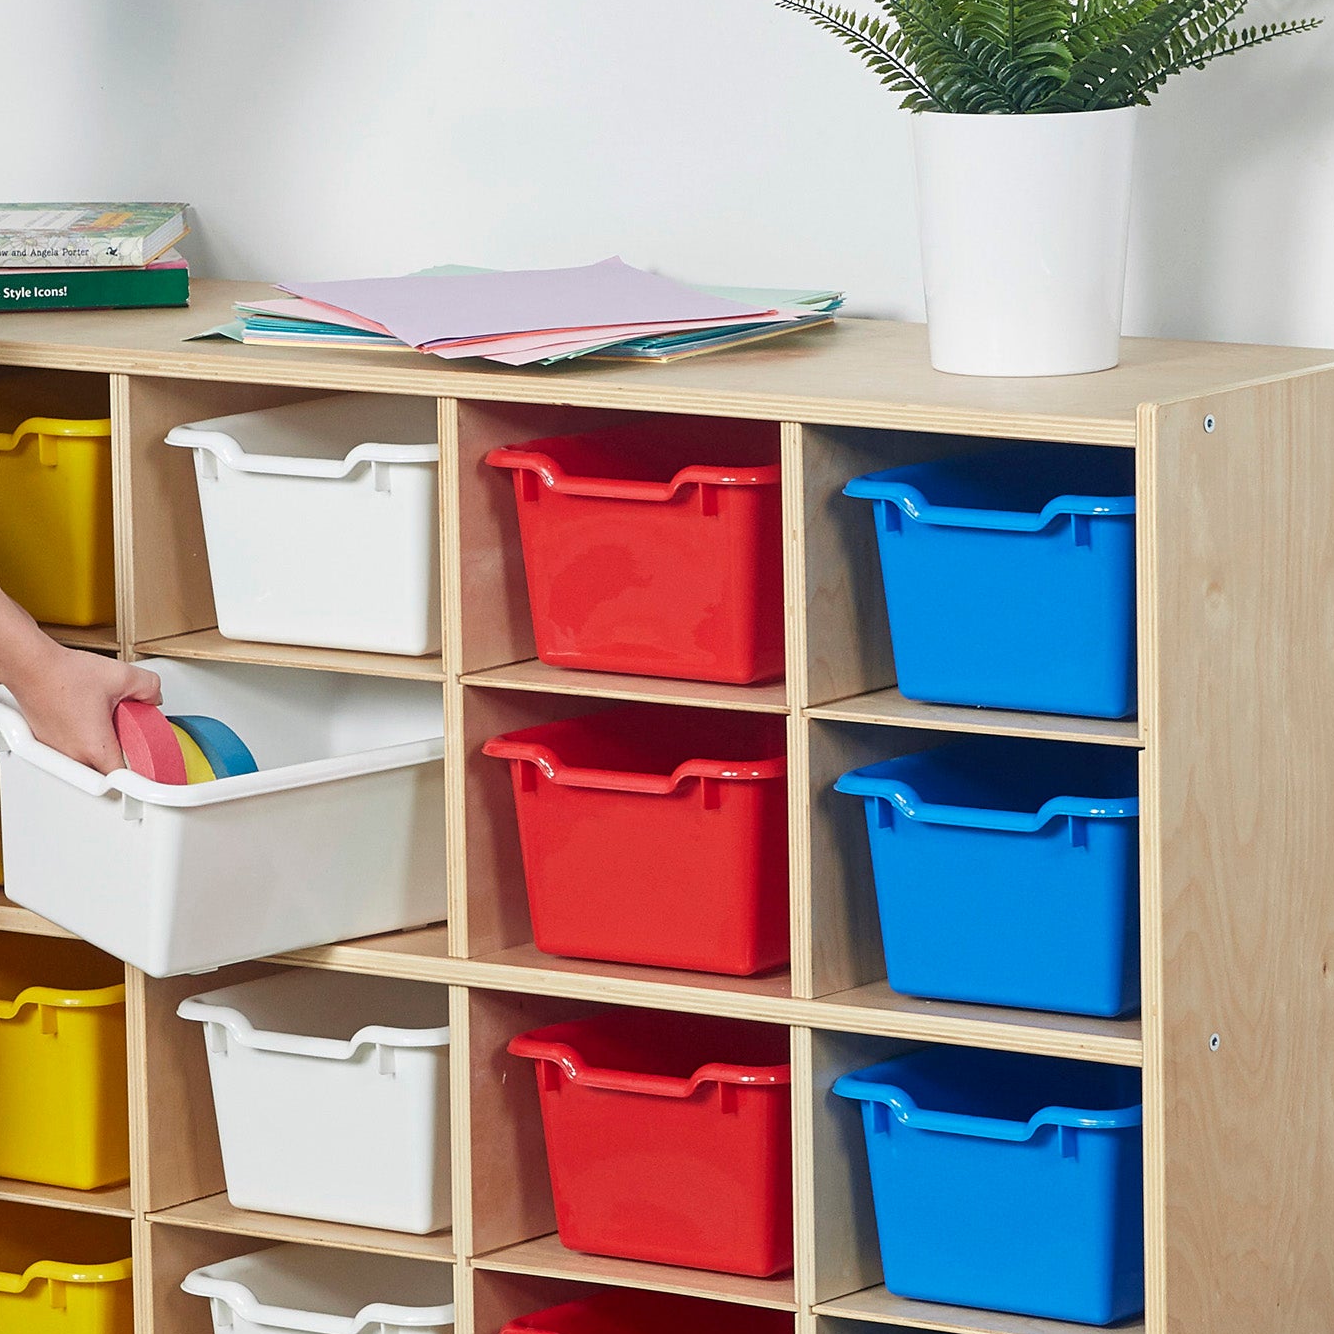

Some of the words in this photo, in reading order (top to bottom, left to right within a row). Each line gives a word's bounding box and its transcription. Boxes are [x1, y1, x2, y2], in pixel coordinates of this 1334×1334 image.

[11, 247, 27, 257] and
[30, 247, 59, 258] Angela
[62, 247, 89, 257] Porter
[3, 286, 32, 301] Style
[34, 286, 68, 298] Icons!
